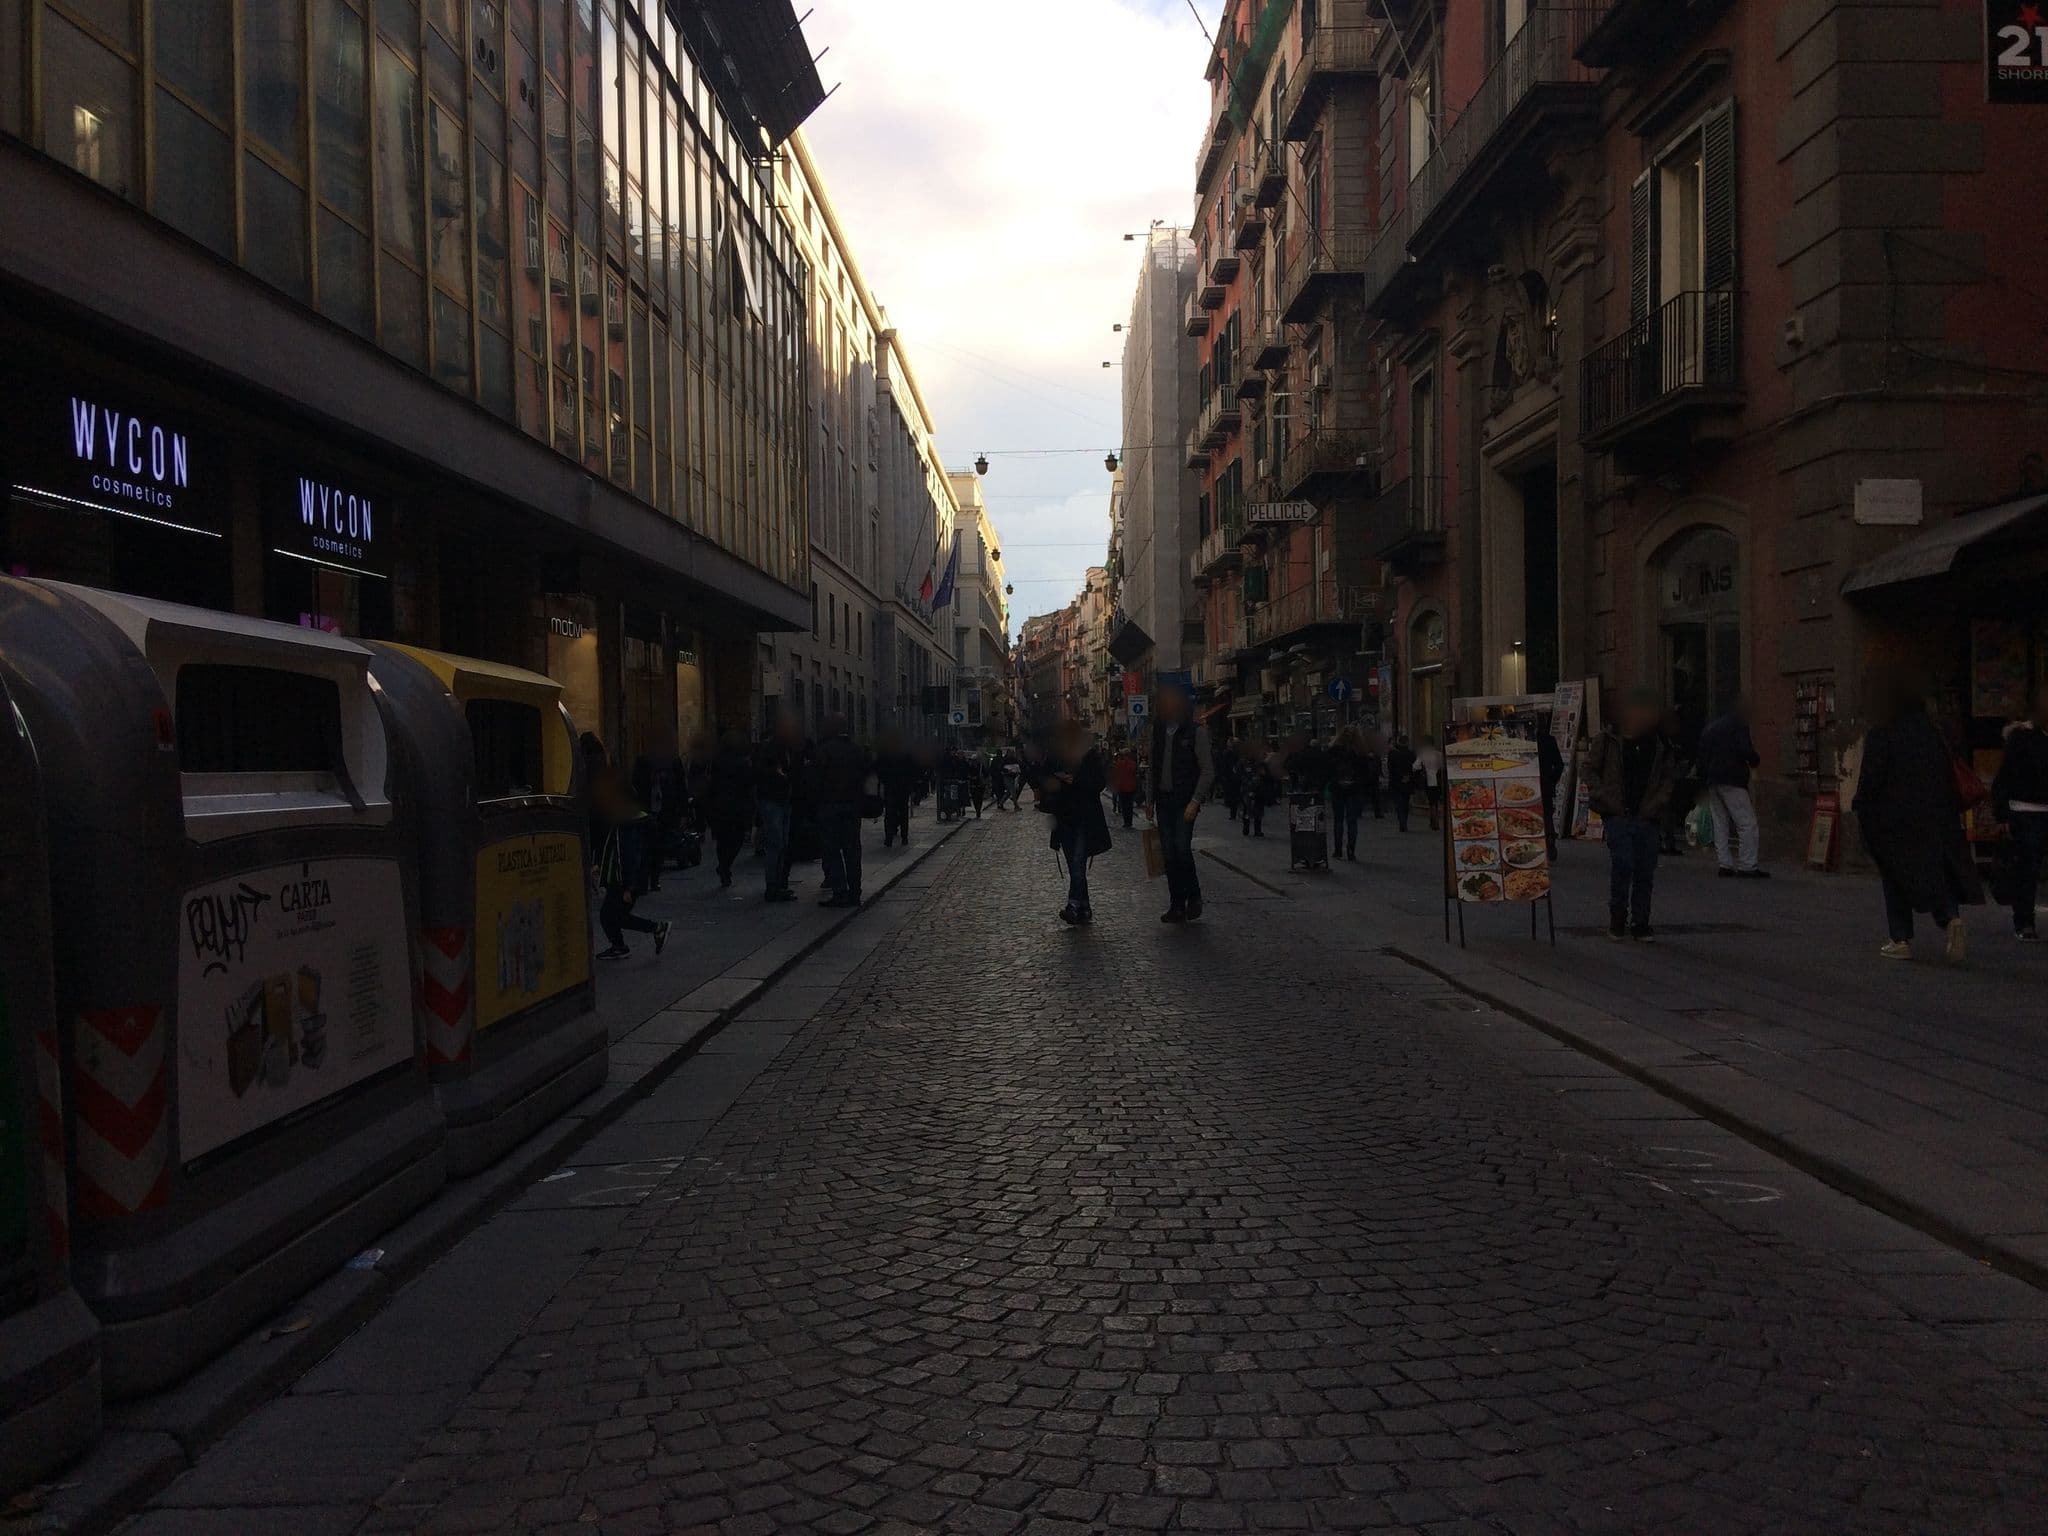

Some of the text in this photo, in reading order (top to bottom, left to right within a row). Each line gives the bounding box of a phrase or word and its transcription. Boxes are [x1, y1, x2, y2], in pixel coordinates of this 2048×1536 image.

[71, 396, 188, 488] WYCON
[91, 472, 173, 509] cosmetics
[299, 476, 372, 543] WYCON
[1249, 503, 1308, 520] PELLICCE
[312, 535, 363, 560] cosmetics
[280, 879, 332, 912] CARTA
